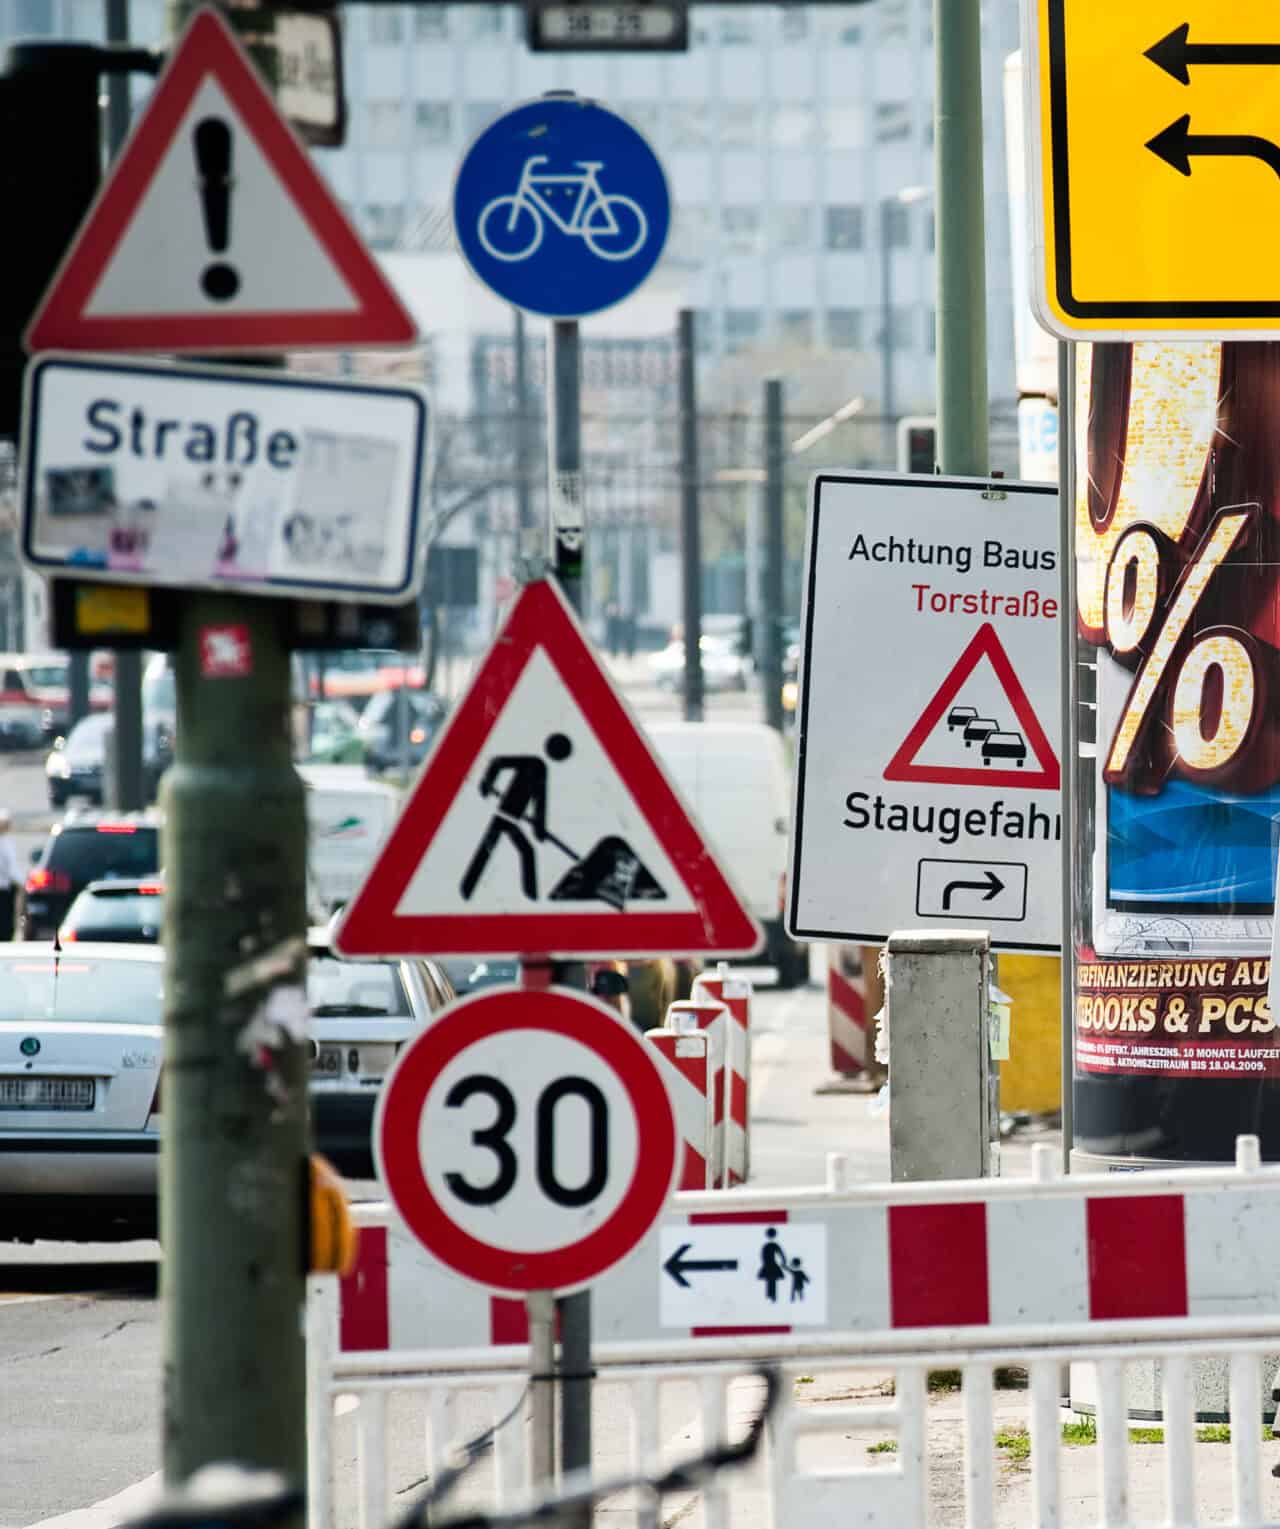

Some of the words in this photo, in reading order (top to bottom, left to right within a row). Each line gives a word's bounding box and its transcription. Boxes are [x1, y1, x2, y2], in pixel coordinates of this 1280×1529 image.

[83, 398, 299, 468] Straße
[848, 534, 972, 572] Achtung
[982, 541, 1060, 571] Baus
[911, 584, 1058, 619] Torstraße
[1164, 998, 1188, 1033] &
[1198, 997, 1276, 1033] PCS
[1183, 1047, 1194, 1058] 10
[1196, 1048, 1235, 1058] MONATE
[444, 1075, 608, 1207] 30
